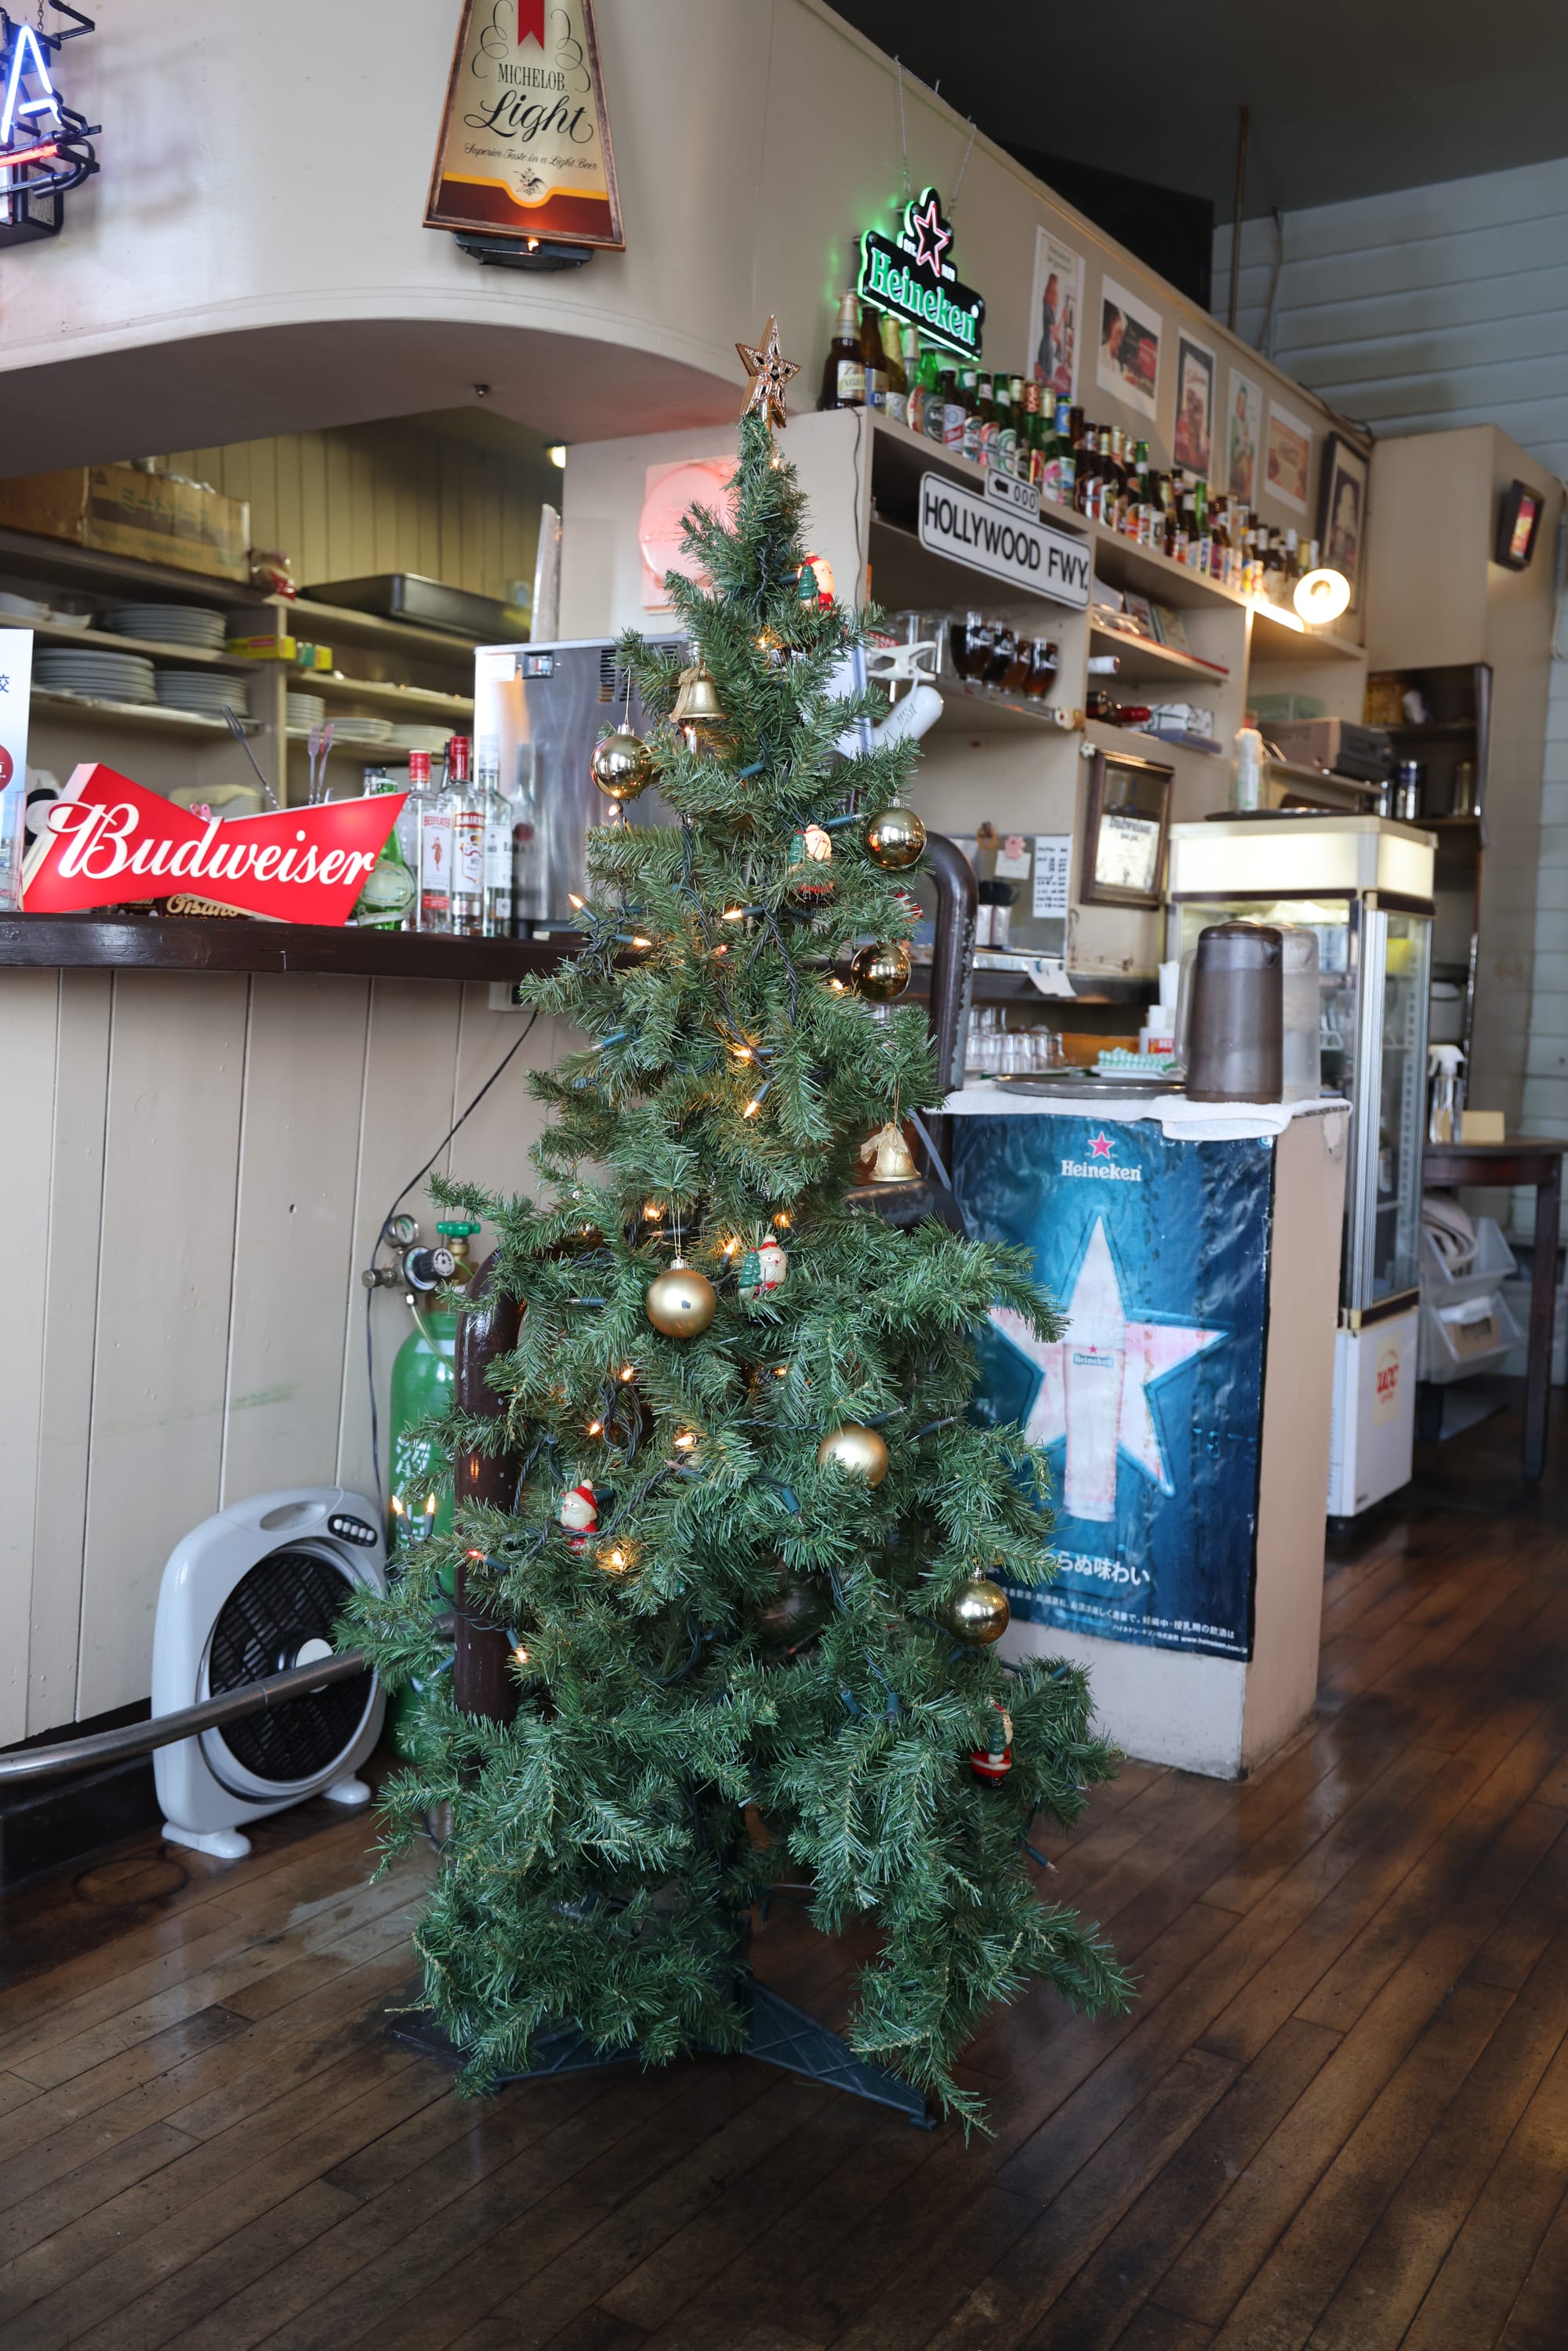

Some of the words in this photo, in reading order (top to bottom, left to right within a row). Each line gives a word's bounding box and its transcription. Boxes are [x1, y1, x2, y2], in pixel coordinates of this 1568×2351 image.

[498, 62, 565, 92] MICHELOB
[464, 90, 593, 143] Light
[464, 143, 502, 158] Superior
[503, 149, 527, 161] Taste
[528, 154, 538, 163] in
[550, 154, 575, 170] Light
[576, 157, 598, 171] Beer
[868, 246, 977, 346] Heineken
[924, 492, 1041, 571] HOLLYWOOD
[1047, 546, 1089, 591] FWY.
[45, 802, 377, 886] Budweiser
[1061, 1160, 1142, 1182] Heineken
